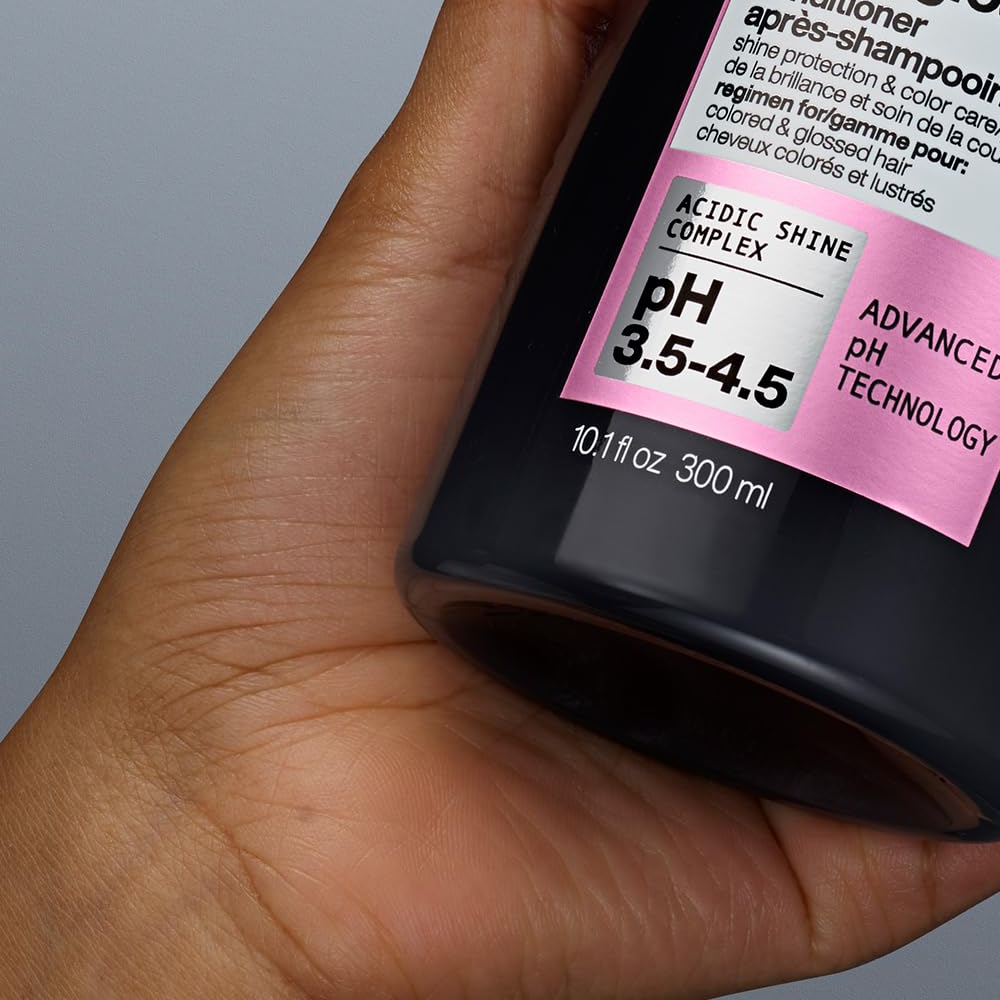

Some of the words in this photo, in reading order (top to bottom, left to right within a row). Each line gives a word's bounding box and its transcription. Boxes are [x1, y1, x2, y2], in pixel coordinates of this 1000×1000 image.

[724, 56, 748, 76] de
[750, 60, 766, 81] la
[768, 65, 847, 102] brillance
[850, 93, 871, 111] et
[872, 101, 913, 126] soin
[917, 116, 943, 137] de
[946, 124, 963, 147] la
[733, 34, 780, 58] shine
[781, 48, 878, 88] protection
[881, 75, 896, 95] &
[900, 85, 952, 114] color
[696, 123, 772, 156] cheveux
[774, 146, 845, 178] colorés
[848, 169, 869, 187] et
[870, 172, 936, 213] lustrés
[706, 104, 775, 132] colored
[776, 117, 790, 137] &
[793, 125, 873, 162] glossed
[873, 145, 913, 176] hair
[714, 80, 794, 112] regimen
[797, 99, 910, 150] for/gamme
[911, 141, 969, 175] pour:
[665, 218, 769, 262] COMPLEX
[675, 193, 763, 232] ACIDIC
[776, 220, 853, 262] SHINE
[631, 273, 724, 324] pH
[612, 323, 795, 410] 3.5-4.5
[845, 333, 889, 368] pH
[836, 364, 998, 457] TECHNOLOGY
[572, 425, 615, 459] 10.1
[614, 435, 633, 464] fl
[632, 447, 667, 474] oz
[675, 453, 733, 494] 300
[734, 479, 774, 510] ml
